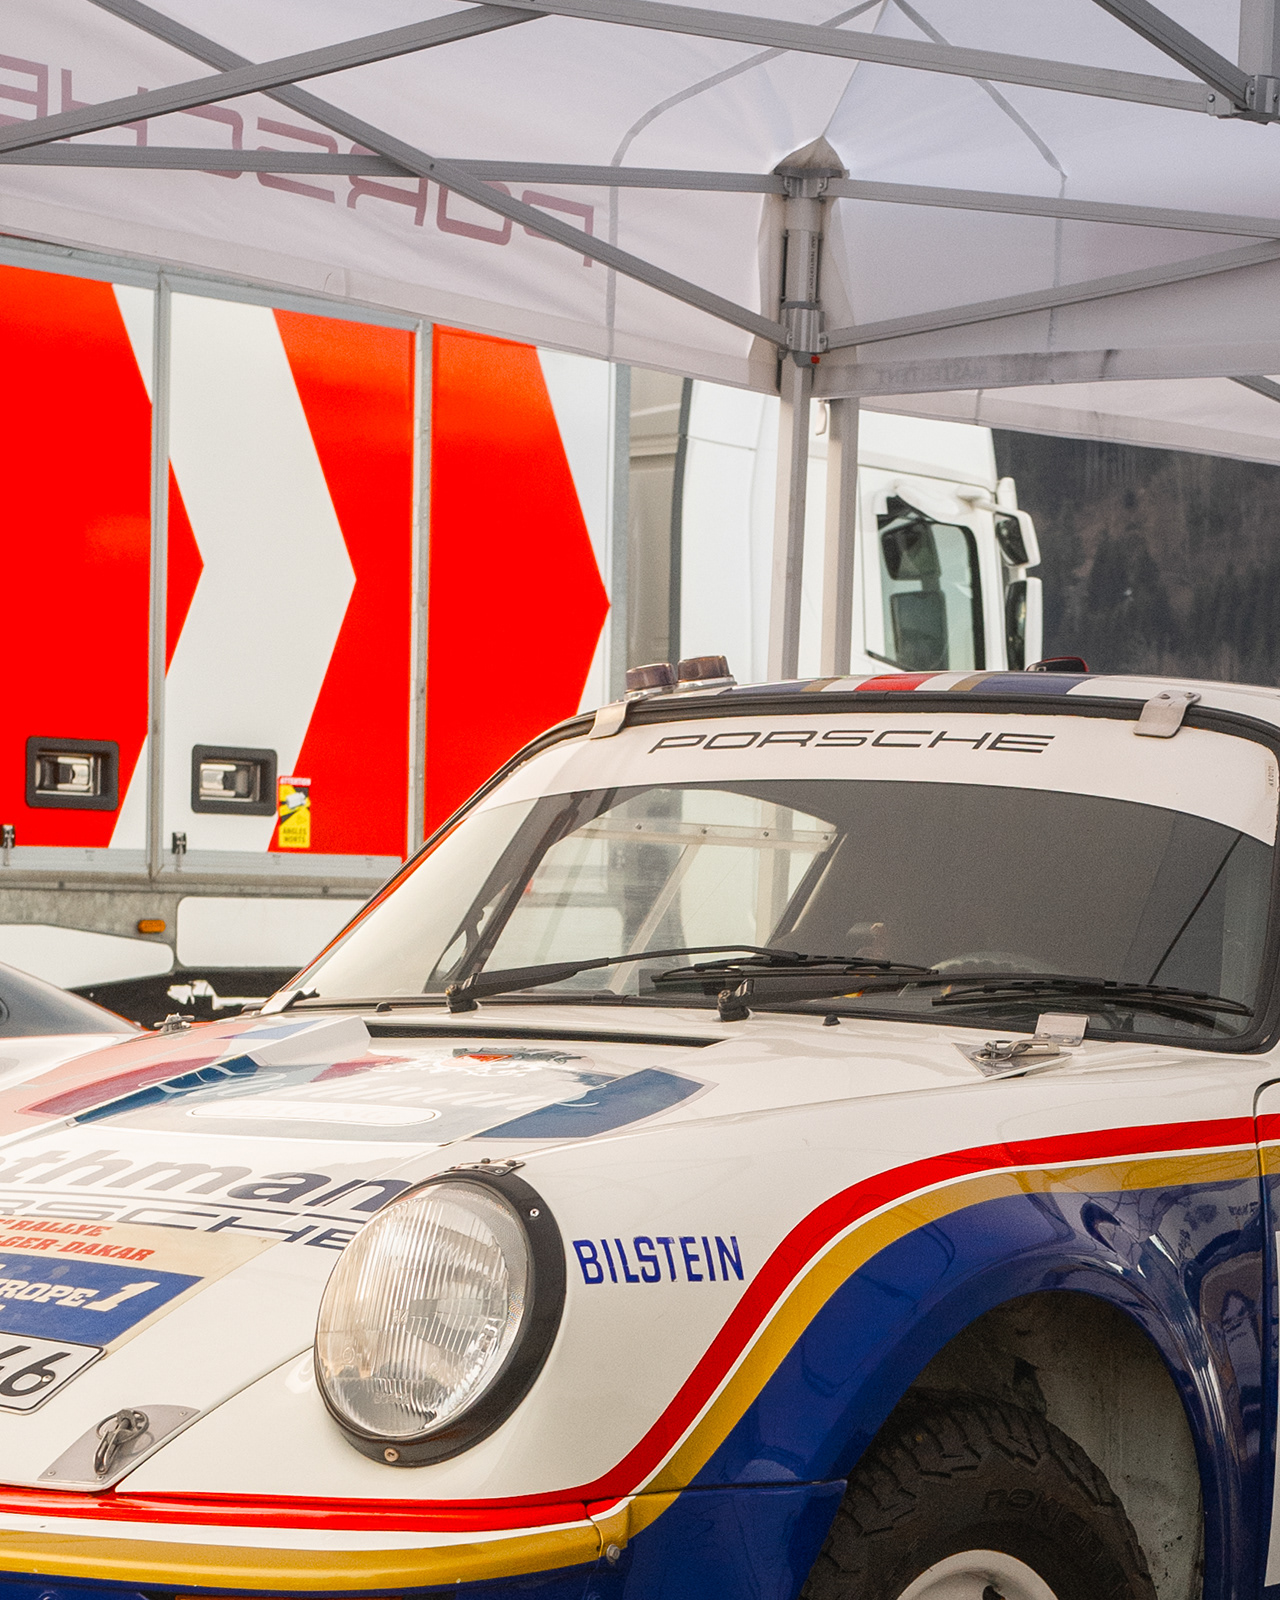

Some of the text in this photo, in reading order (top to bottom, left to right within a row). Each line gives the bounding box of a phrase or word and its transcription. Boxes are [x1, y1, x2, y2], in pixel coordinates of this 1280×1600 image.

[648, 728, 1053, 754] PORSCHE
[13, 1219, 114, 1238] RALLYE
[572, 1236, 745, 1285] BILSTEIN
